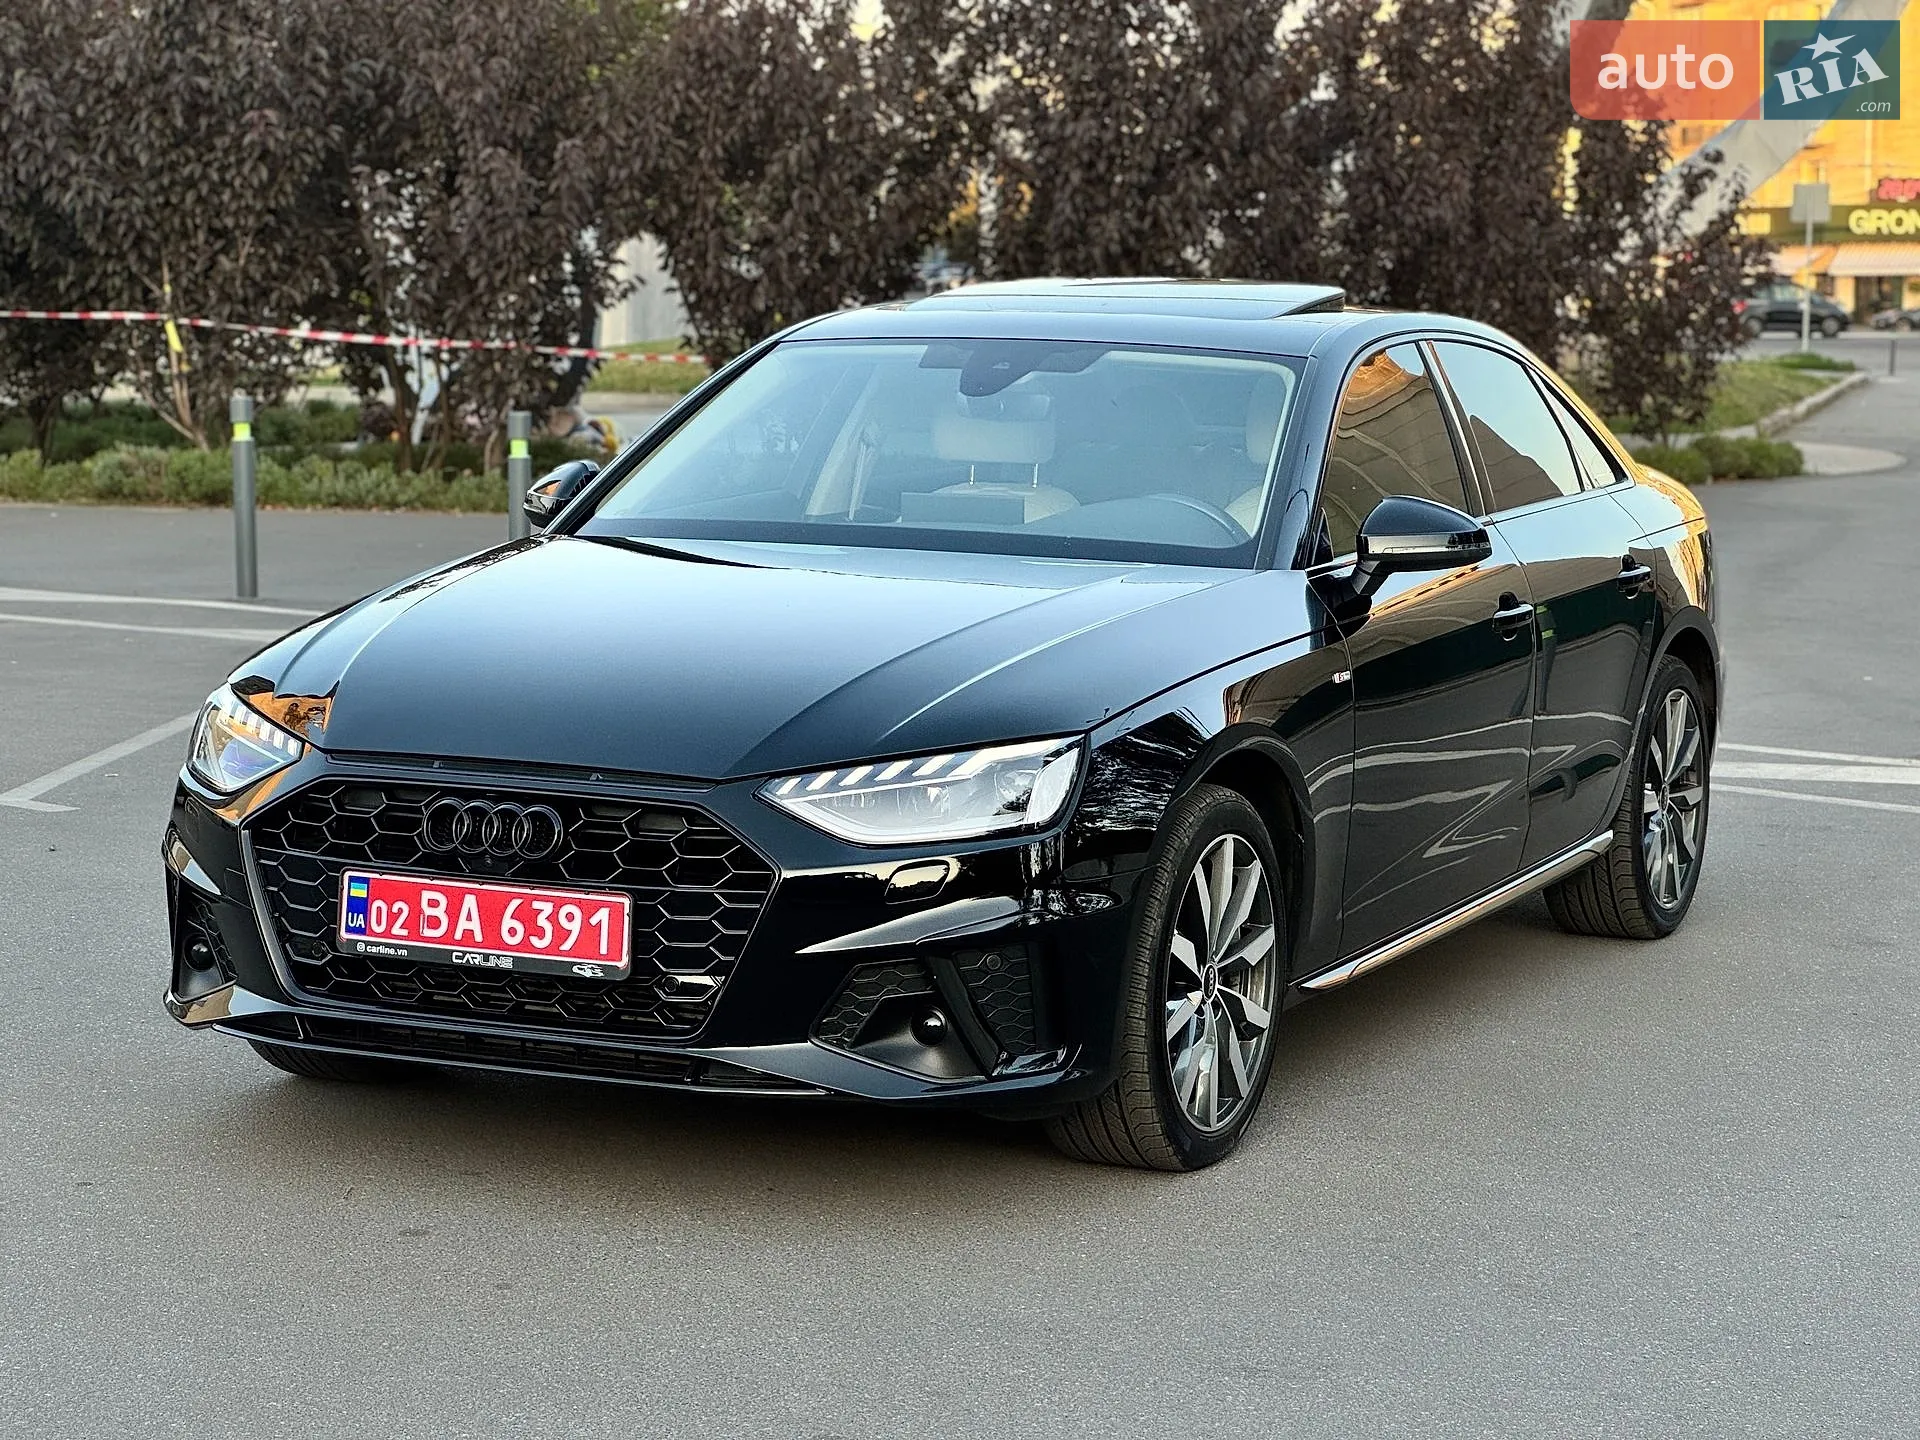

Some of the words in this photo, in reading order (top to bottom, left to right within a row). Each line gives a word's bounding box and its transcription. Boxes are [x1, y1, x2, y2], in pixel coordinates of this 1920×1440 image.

[348, 911, 365, 929] UA
[370, 899, 410, 936] 02
[420, 889, 483, 943] BA
[500, 899, 611, 955] 6391
[366, 943, 408, 957] carline.vn
[452, 951, 513, 969] CARLINE
